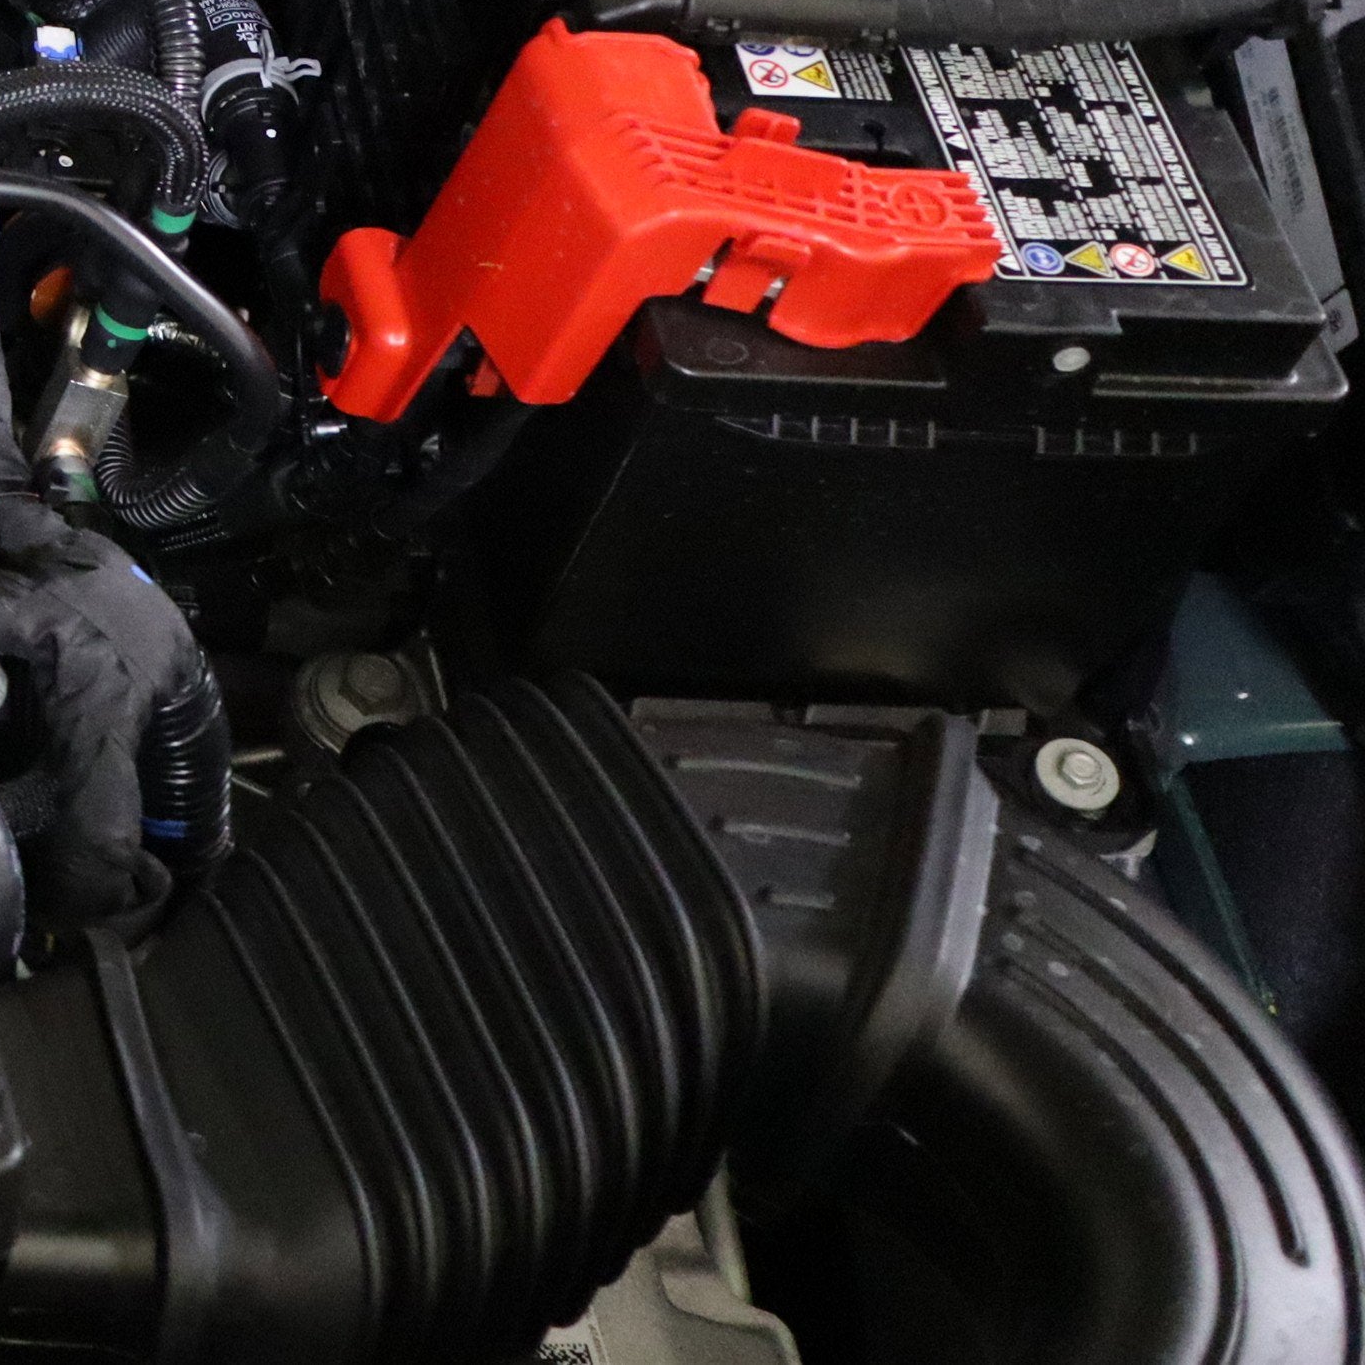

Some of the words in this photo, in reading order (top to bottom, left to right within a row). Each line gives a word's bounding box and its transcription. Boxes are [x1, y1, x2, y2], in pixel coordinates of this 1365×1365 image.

[1125, 87, 1150, 100] LA
[1133, 101, 1158, 116] NO
[1164, 163, 1193, 183] PAS
[1175, 185, 1201, 199] NE
[1201, 236, 1231, 257] NOT
[1213, 259, 1240, 274] DO
